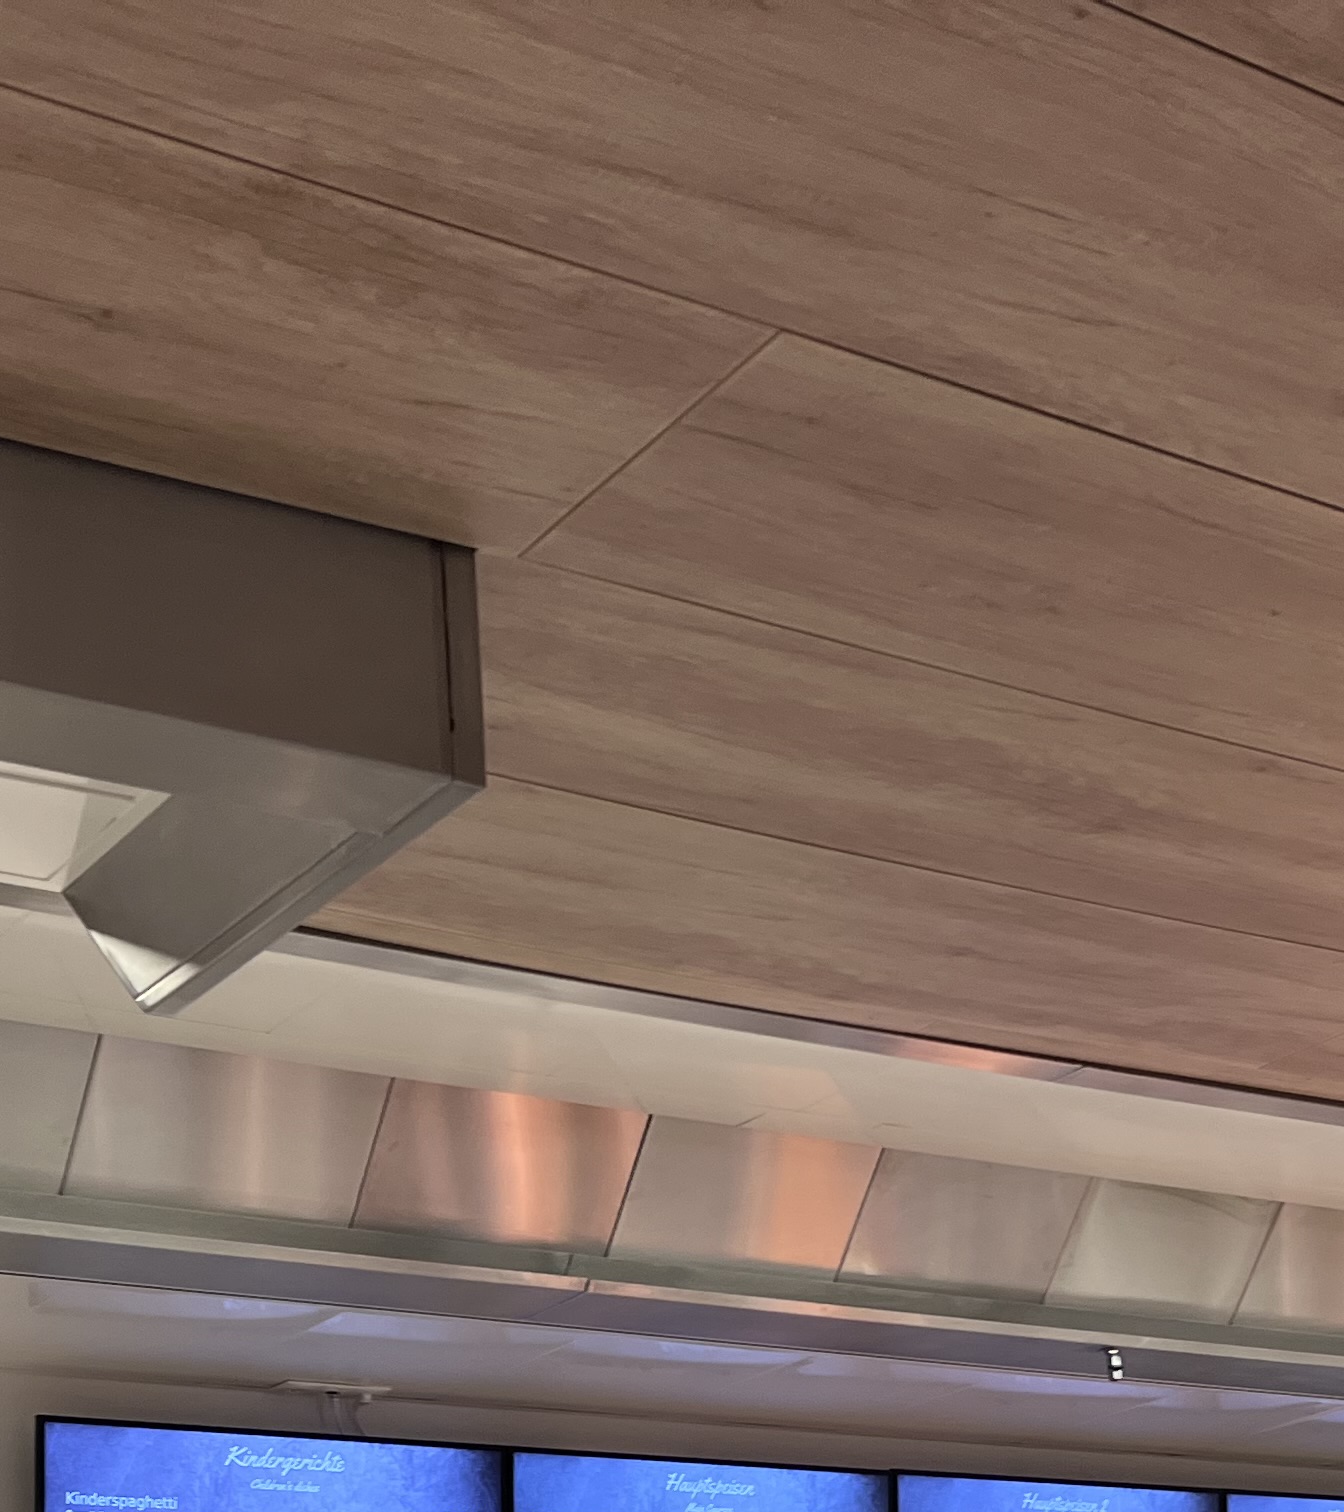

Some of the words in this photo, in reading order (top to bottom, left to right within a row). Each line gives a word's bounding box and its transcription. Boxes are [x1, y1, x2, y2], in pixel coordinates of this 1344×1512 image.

[224, 1445, 346, 1476] Kindergerichte
[666, 1472, 755, 1500] Hauptspeisen
[65, 1491, 178, 1511] Kinderspaghetti
